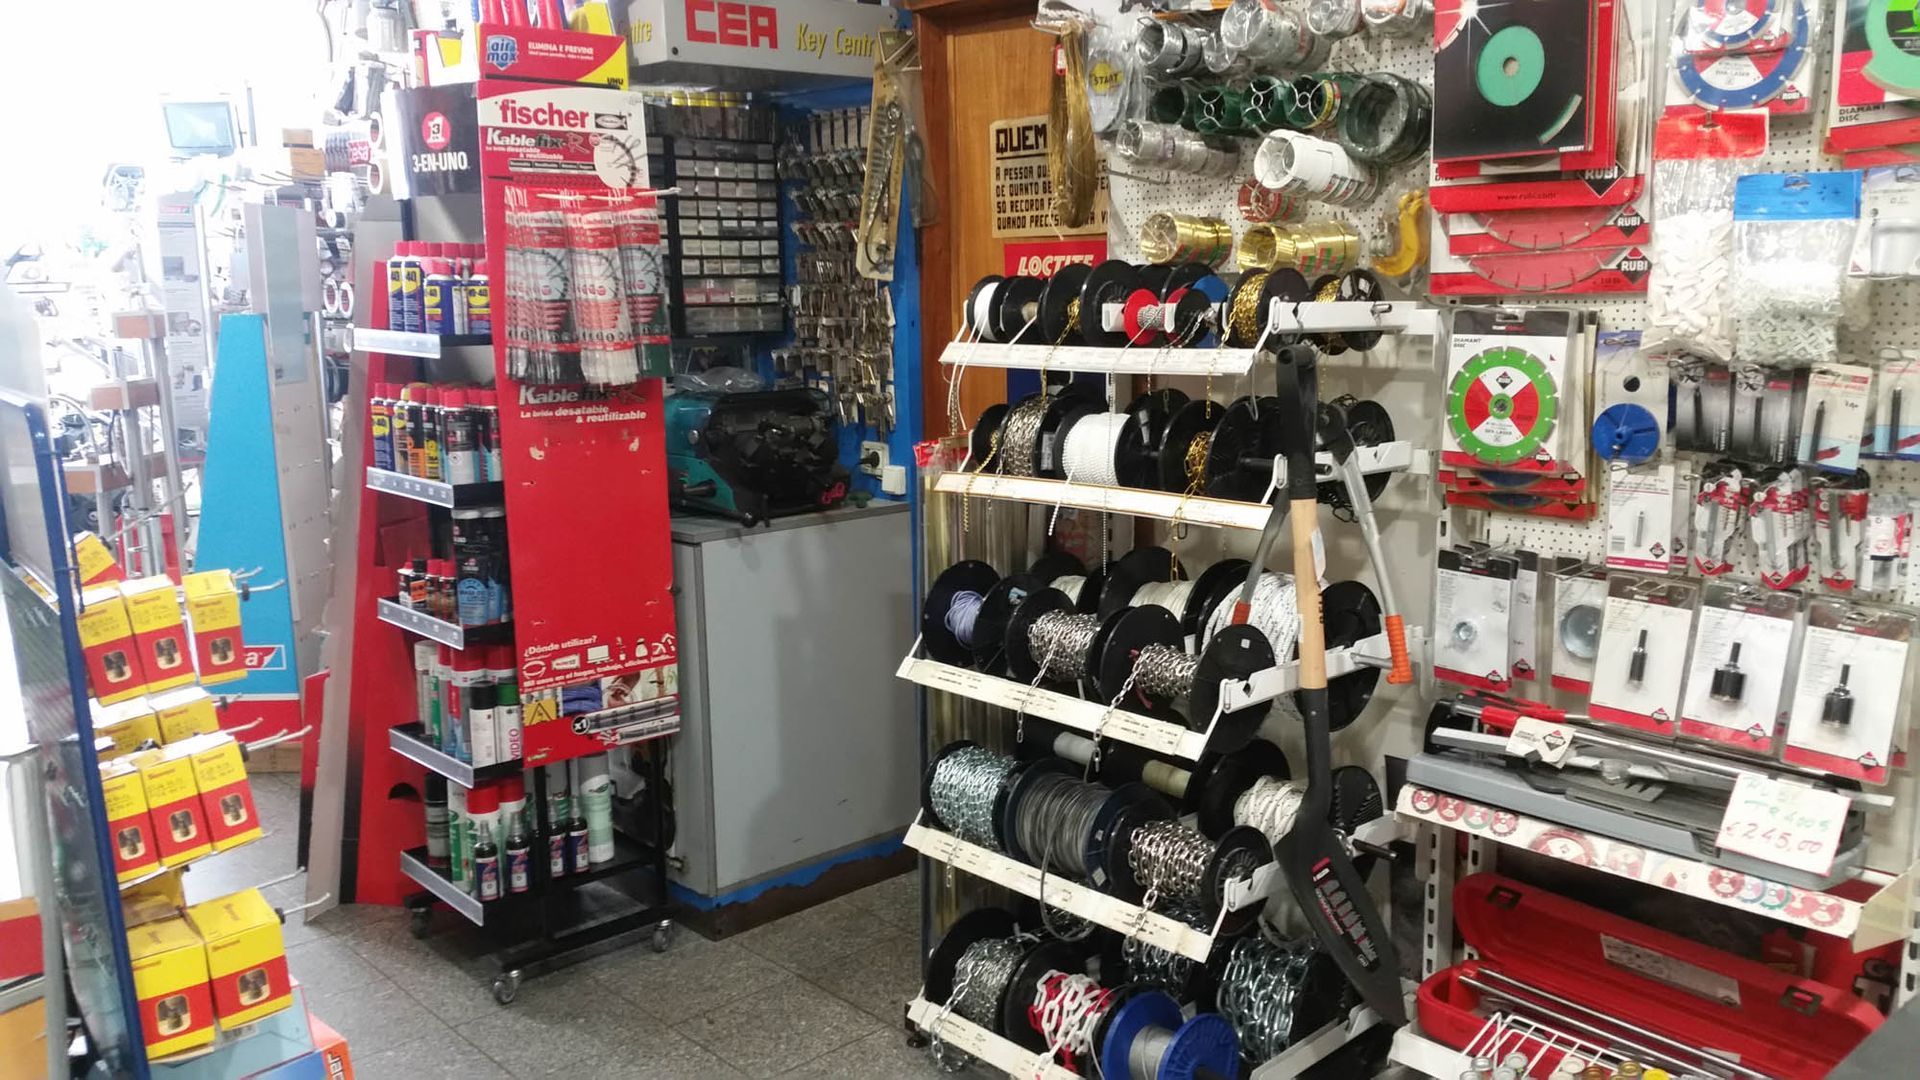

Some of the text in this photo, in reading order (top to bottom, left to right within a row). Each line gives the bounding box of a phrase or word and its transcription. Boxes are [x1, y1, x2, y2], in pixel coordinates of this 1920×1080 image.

[684, 0, 778, 49] CEA
[797, 23, 826, 59] Key
[500, 99, 590, 128] fischer
[996, 124, 1047, 154] QUEM
[1617, 216, 1640, 227] RUBI
[1621, 259, 1648, 272] RUBI
[555, 404, 609, 416] desatable
[586, 410, 647, 423] reutilizable
[561, 635, 597, 649] utilizar?
